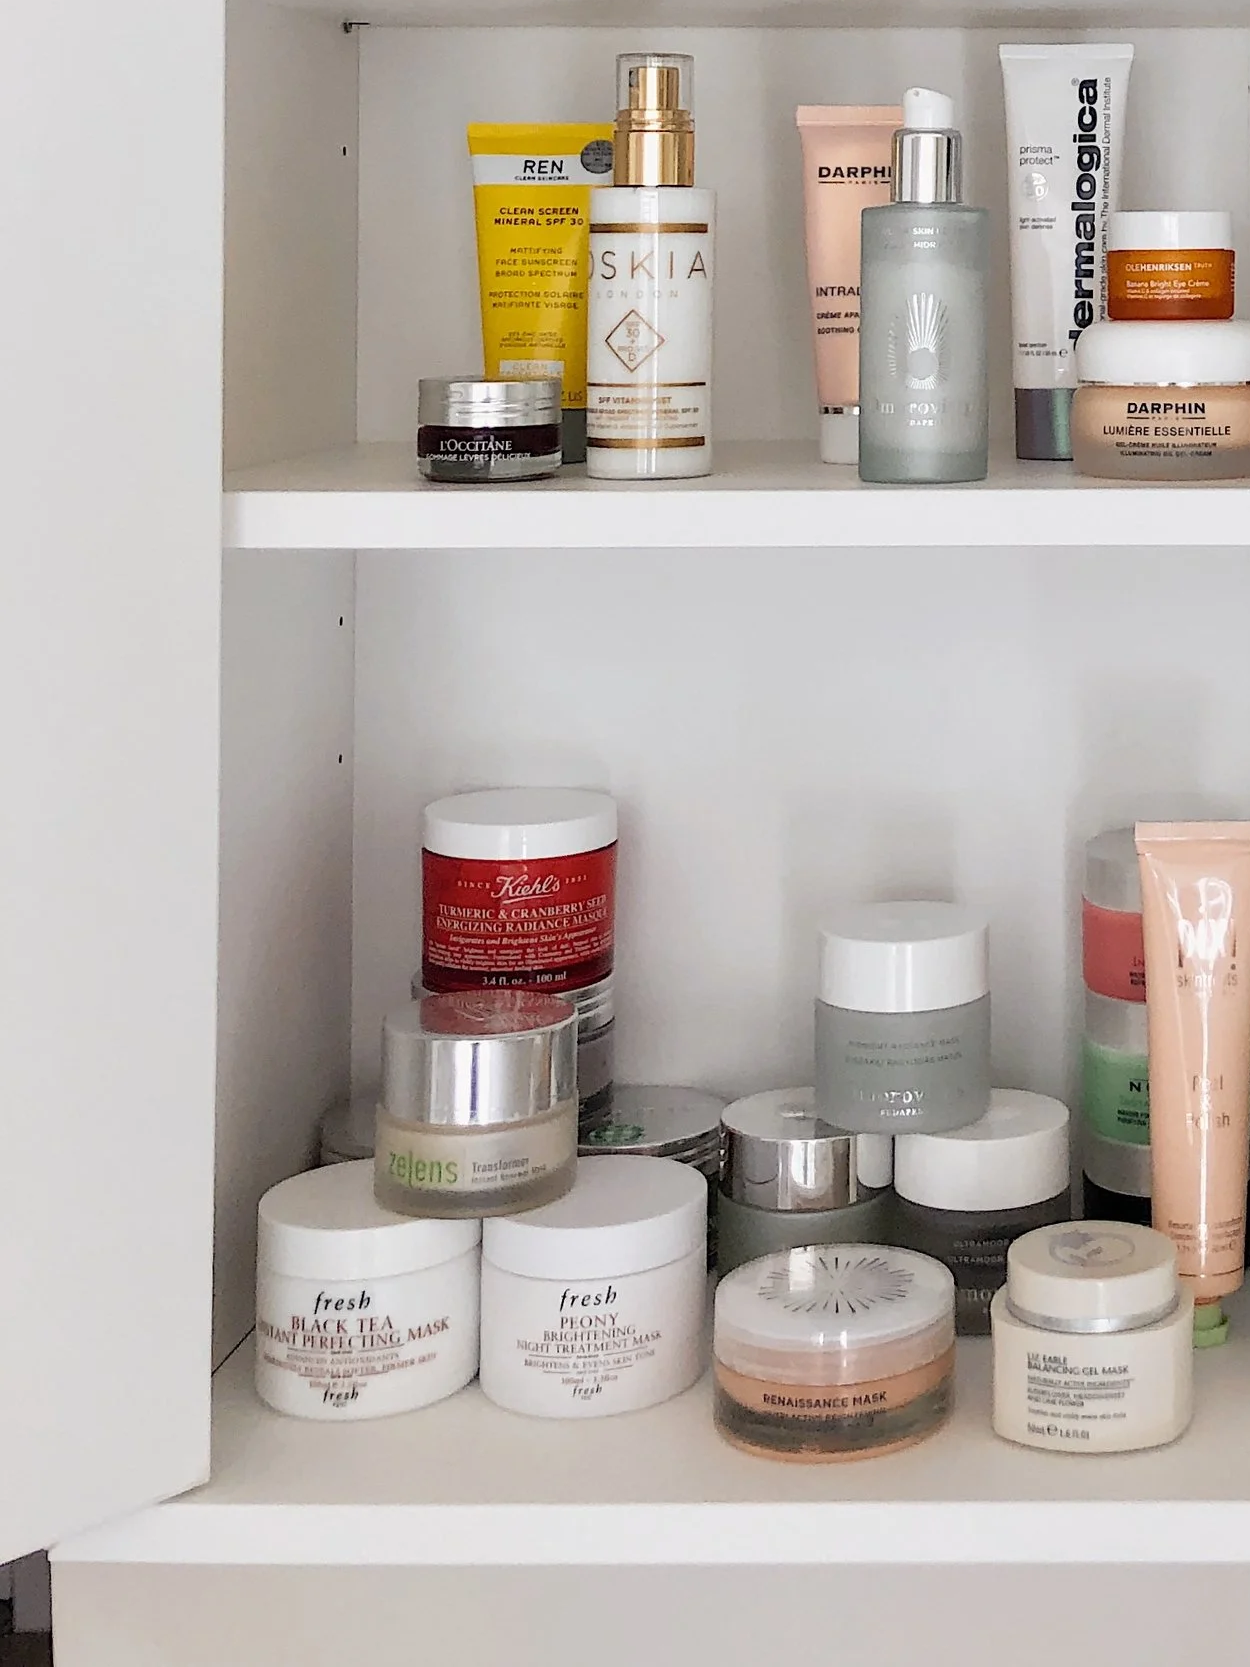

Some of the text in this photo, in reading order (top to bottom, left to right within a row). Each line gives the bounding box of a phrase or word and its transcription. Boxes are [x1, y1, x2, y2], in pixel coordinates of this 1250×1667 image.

[1102, 77, 1111, 199] International Institute
[1019, 146, 1052, 156] prisma
[523, 160, 564, 174] REN
[818, 166, 891, 178] DARPHI
[494, 218, 541, 226] MINERAL
[1126, 263, 1191, 271] OLEHENRIKSEN
[1173, 280, 1186, 289] Eye
[1128, 403, 1205, 414] DARPHIN
[1103, 425, 1231, 436] LUMIÈRE ESSENTIELLE
[458, 875, 560, 898] SINCE Kiehl's
[439, 902, 585, 919] TURMERIC & CRANBERRY
[436, 916, 570, 932] ENERGIZING RADIANCE
[537, 971, 567, 983] 100 ml
[390, 1150, 458, 1189] zelens
[472, 1157, 529, 1173] Transformer
[314, 1290, 371, 1314] fresh
[560, 1285, 617, 1312] fresh
[292, 1315, 393, 1334] BLACK TEA
[560, 1312, 619, 1329] PEONY
[302, 1316, 450, 1349] PERFECTING MASK
[544, 1324, 636, 1342] BRIGHTENING
[516, 1330, 662, 1354] NIGHT TREATMENT MASK
[1028, 1361, 1129, 1375] BALANCING GEL MASK
[323, 1387, 359, 1403] fresh
[572, 1384, 602, 1397] fresh
[763, 1391, 887, 1408] RENAISSANCE MASK
